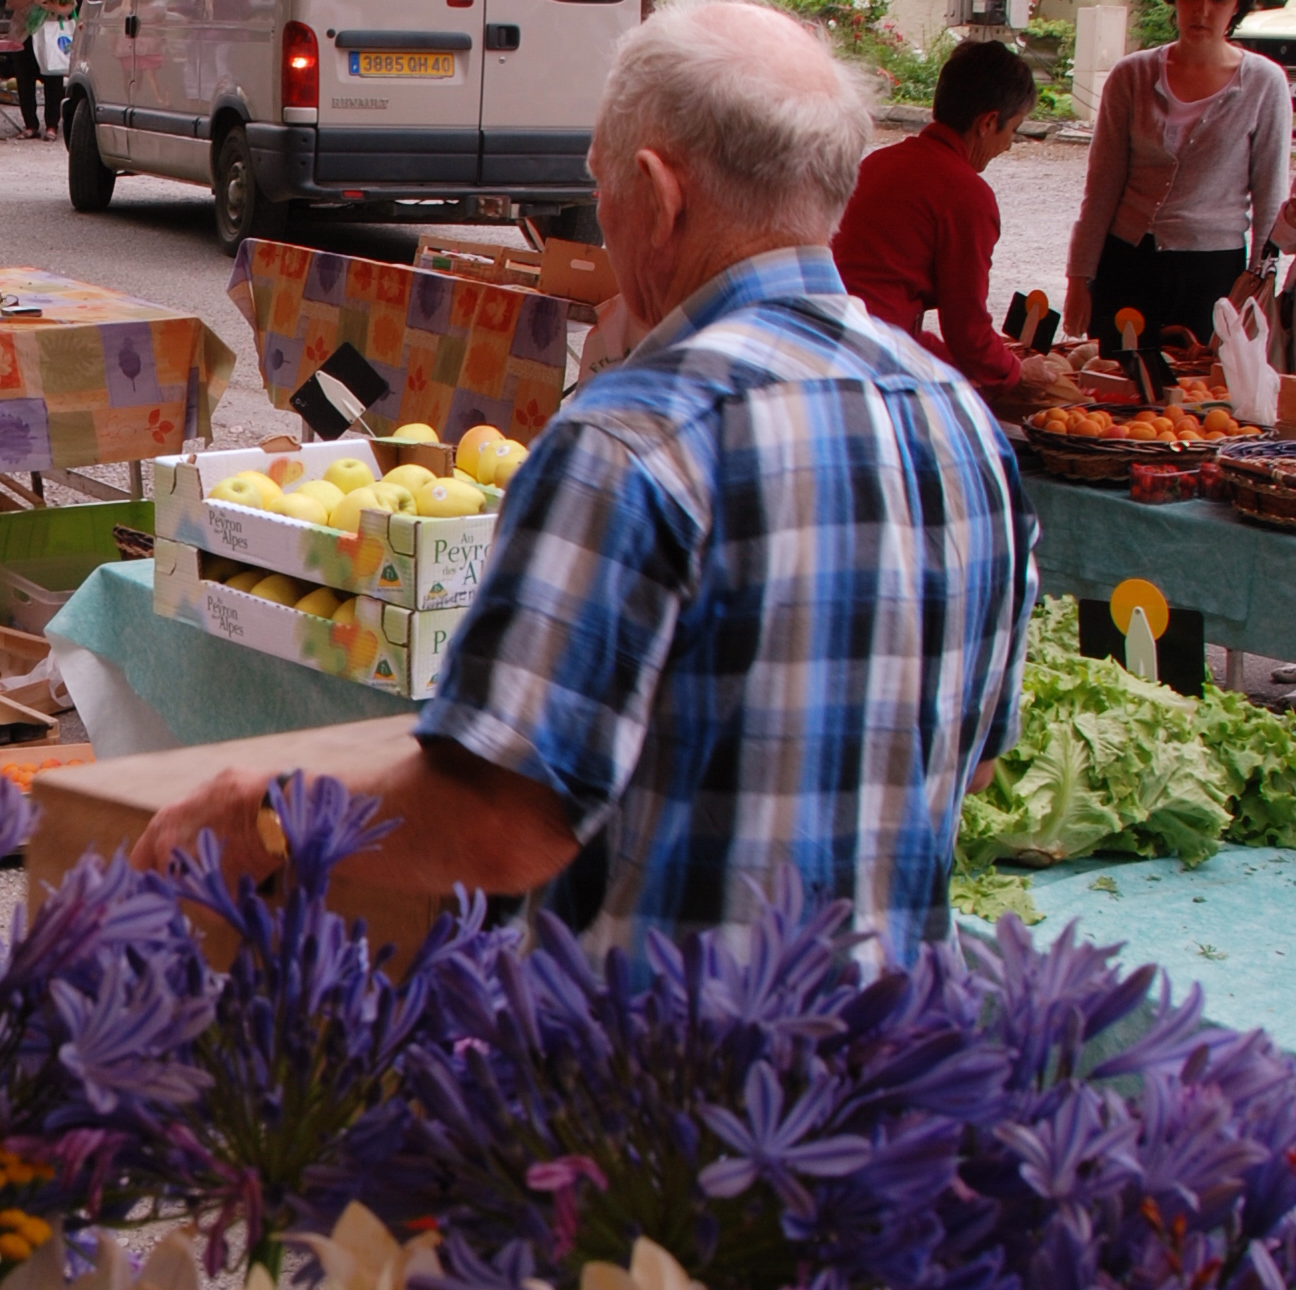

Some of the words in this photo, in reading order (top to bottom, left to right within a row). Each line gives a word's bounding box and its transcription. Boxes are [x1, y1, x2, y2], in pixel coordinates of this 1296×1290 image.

[331, 97, 389, 109] RENAULT
[209, 510, 242, 533] Peyron
[222, 529, 248, 551] Alpes
[461, 533, 474, 544] Au
